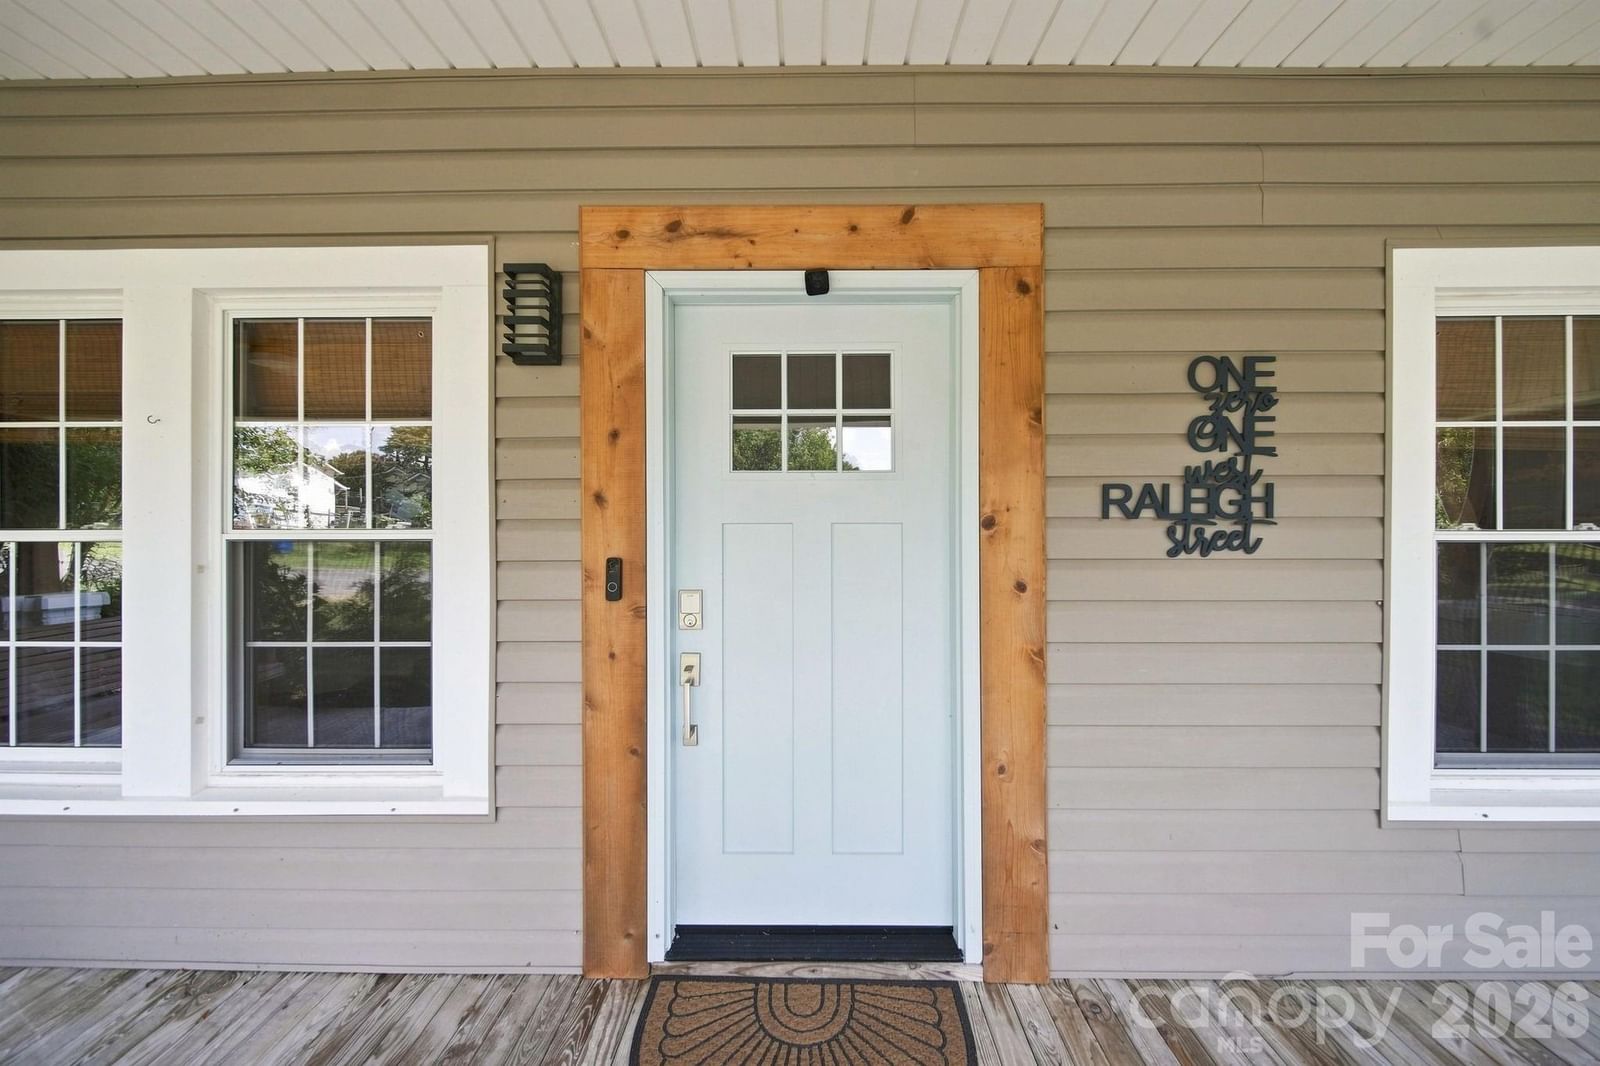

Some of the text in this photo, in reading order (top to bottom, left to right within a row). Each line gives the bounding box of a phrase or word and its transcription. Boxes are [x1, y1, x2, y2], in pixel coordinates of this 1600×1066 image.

[1187, 355, 1277, 393] ONE
[1187, 415, 1276, 453] ONE
[1101, 482, 1275, 520] RALEIGH
[1166, 513, 1278, 558] street
